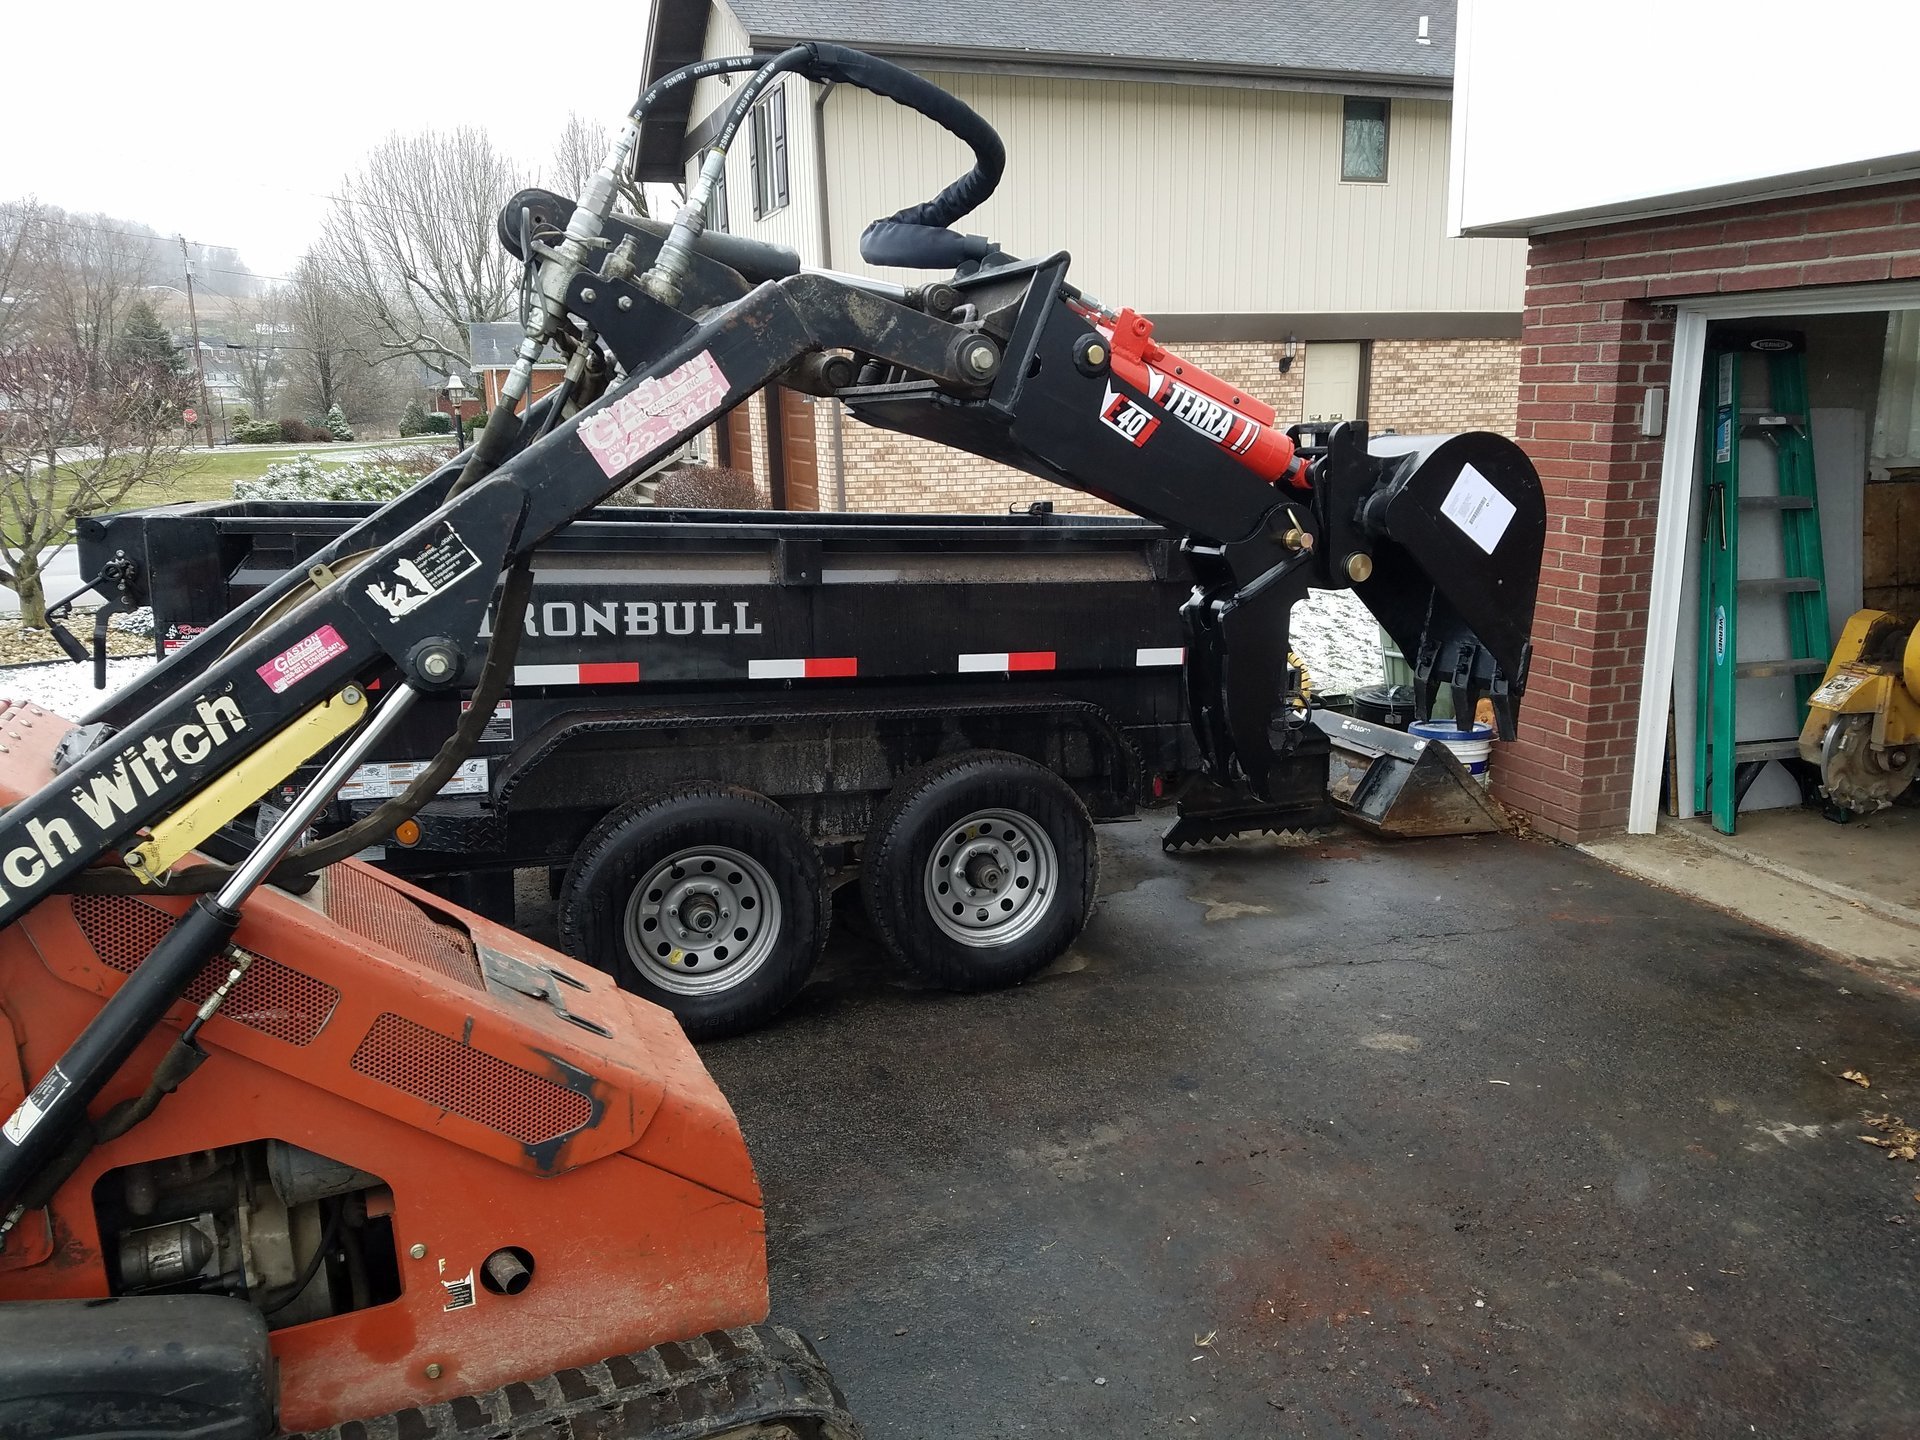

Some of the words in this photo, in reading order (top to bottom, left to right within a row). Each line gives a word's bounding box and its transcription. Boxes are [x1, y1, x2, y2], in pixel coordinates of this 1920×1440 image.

[663, 71, 687, 89] 2SN/R2
[708, 62, 720, 70] PSI
[726, 59, 741, 67] MAX
[719, 122, 736, 149] 2SN/R2
[744, 88, 755, 100] PSI
[756, 70, 768, 84] MAX
[766, 62, 776, 73] WP
[587, 354, 709, 449] GASTON
[609, 385, 727, 469] 922-8471
[274, 633, 319, 672] GASTON
[0, 817, 82, 909] ch
[71, 695, 247, 831] Witch
